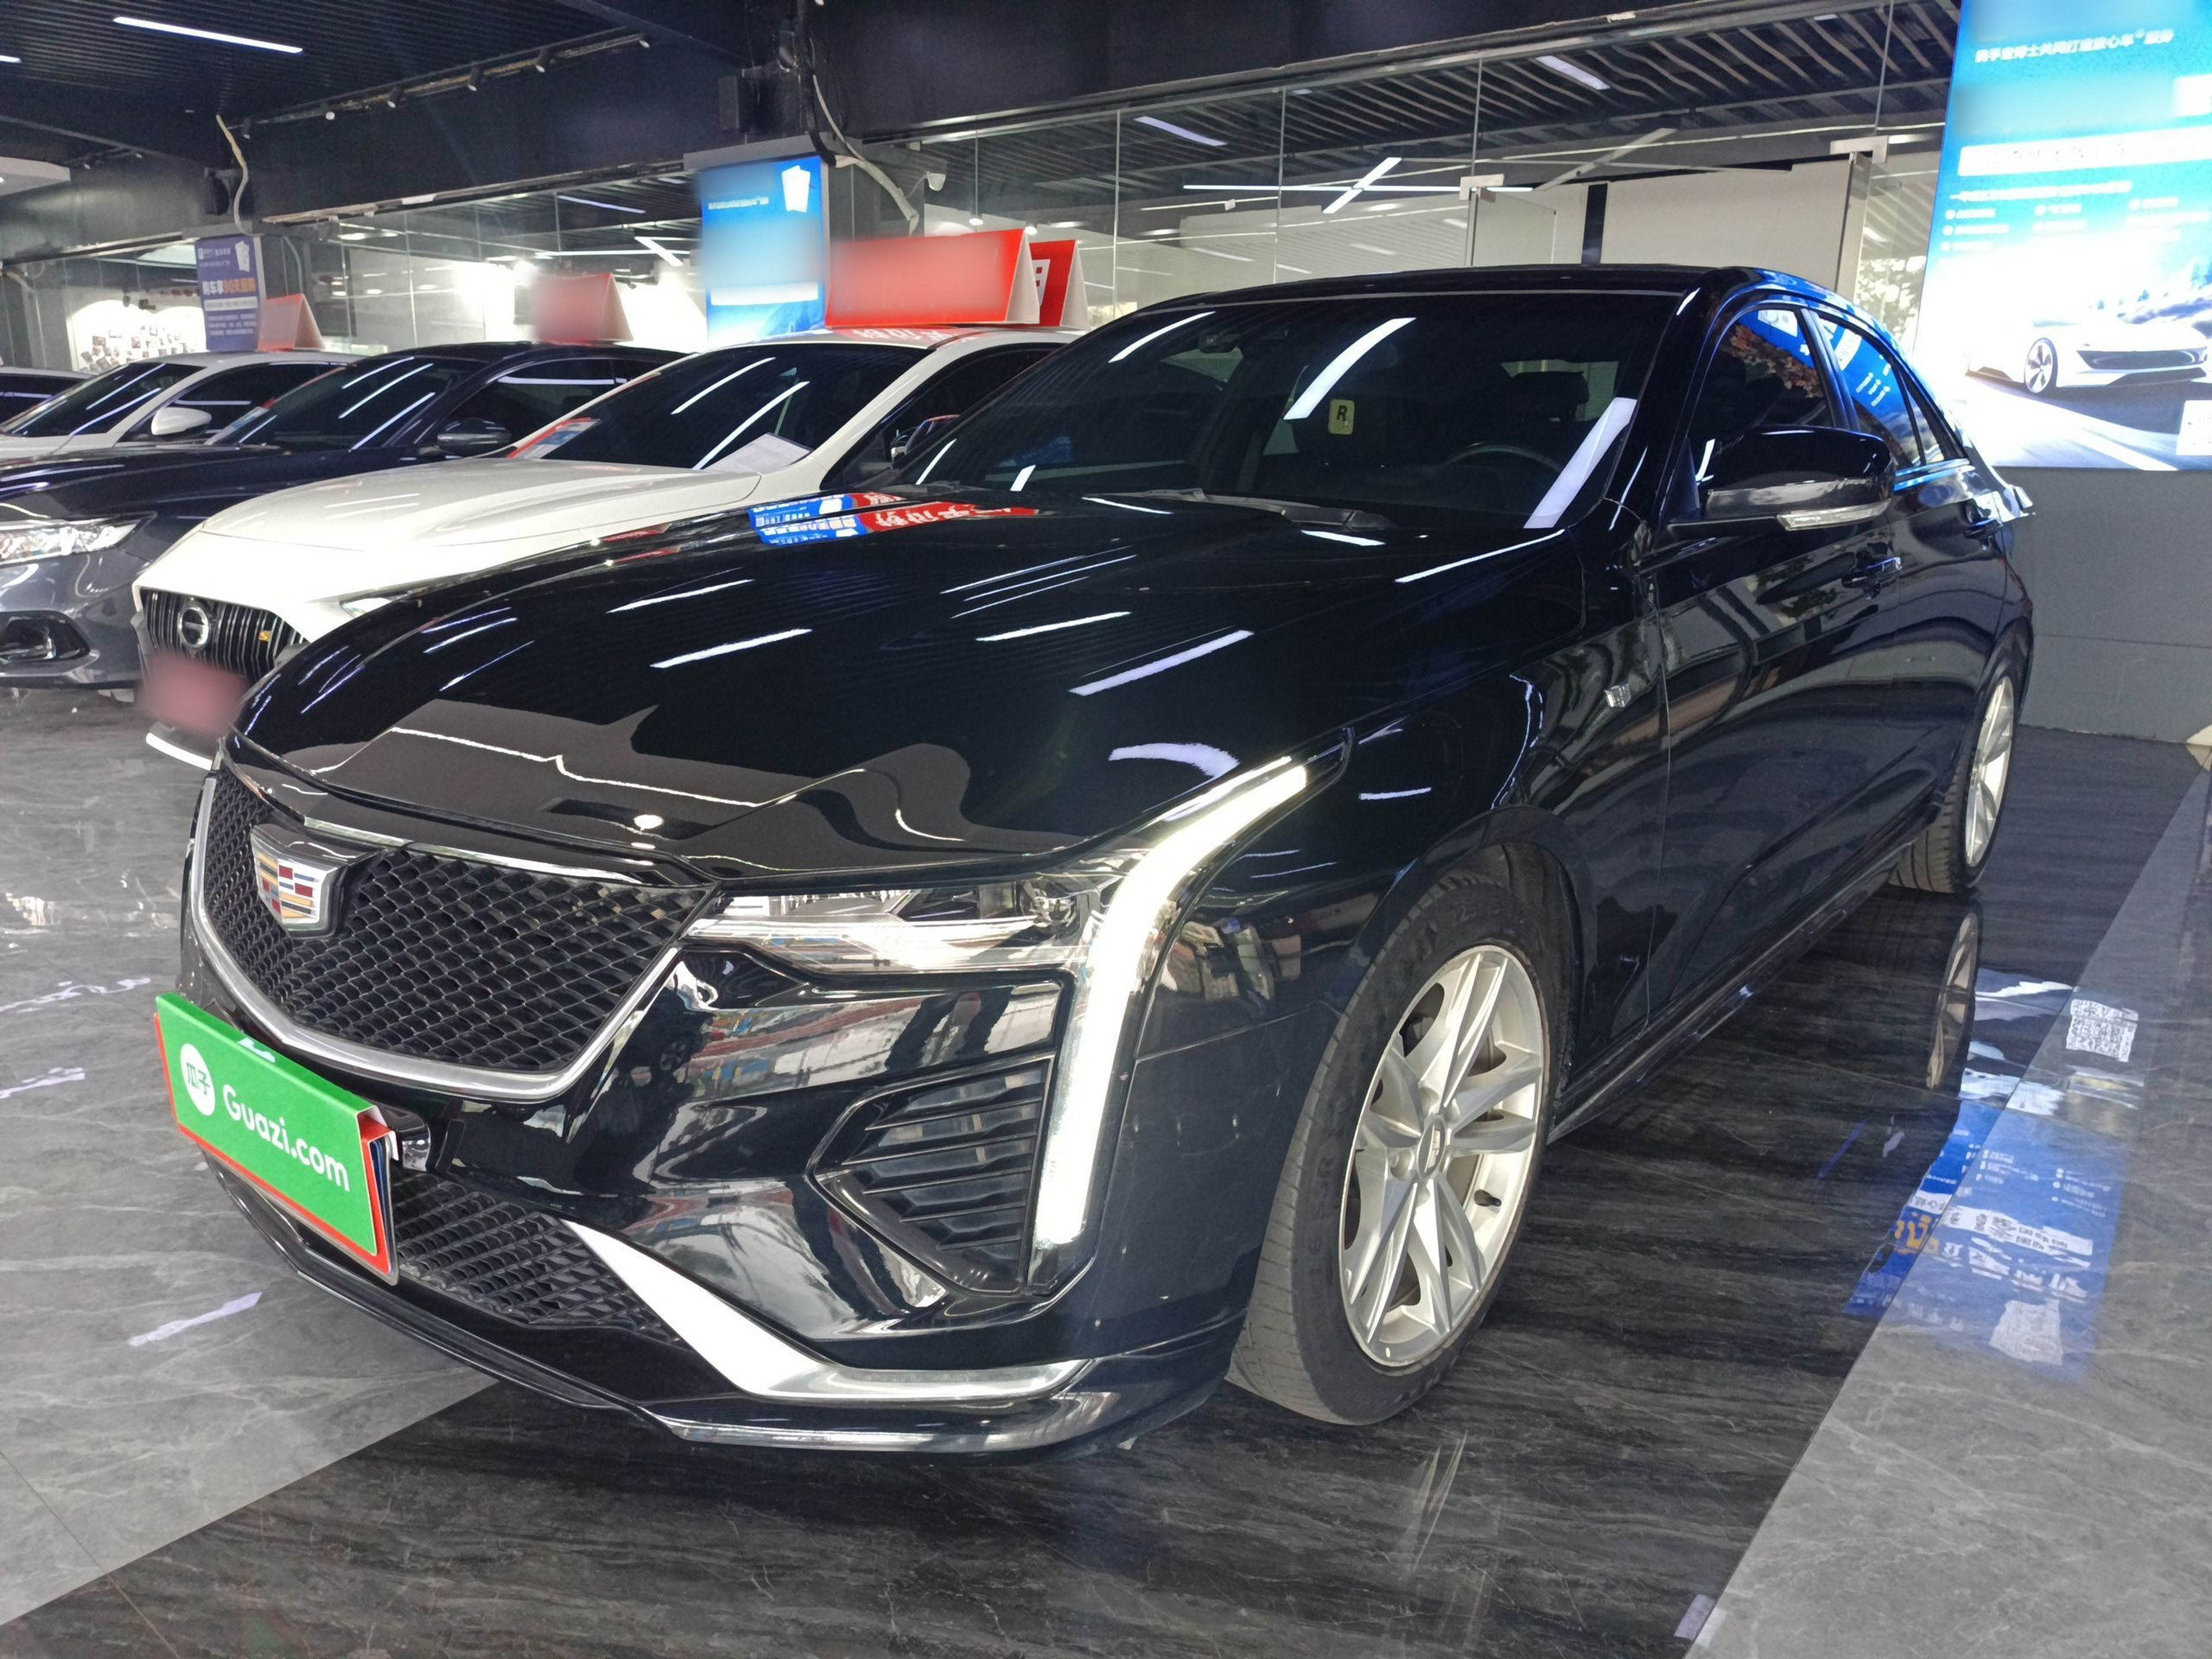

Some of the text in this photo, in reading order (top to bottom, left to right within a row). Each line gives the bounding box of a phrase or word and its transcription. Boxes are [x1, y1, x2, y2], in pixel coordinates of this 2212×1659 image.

[1336, 404, 1348, 422] R
[185, 1062, 210, 1096] 瓜子
[222, 1084, 350, 1192] Guazi.com
